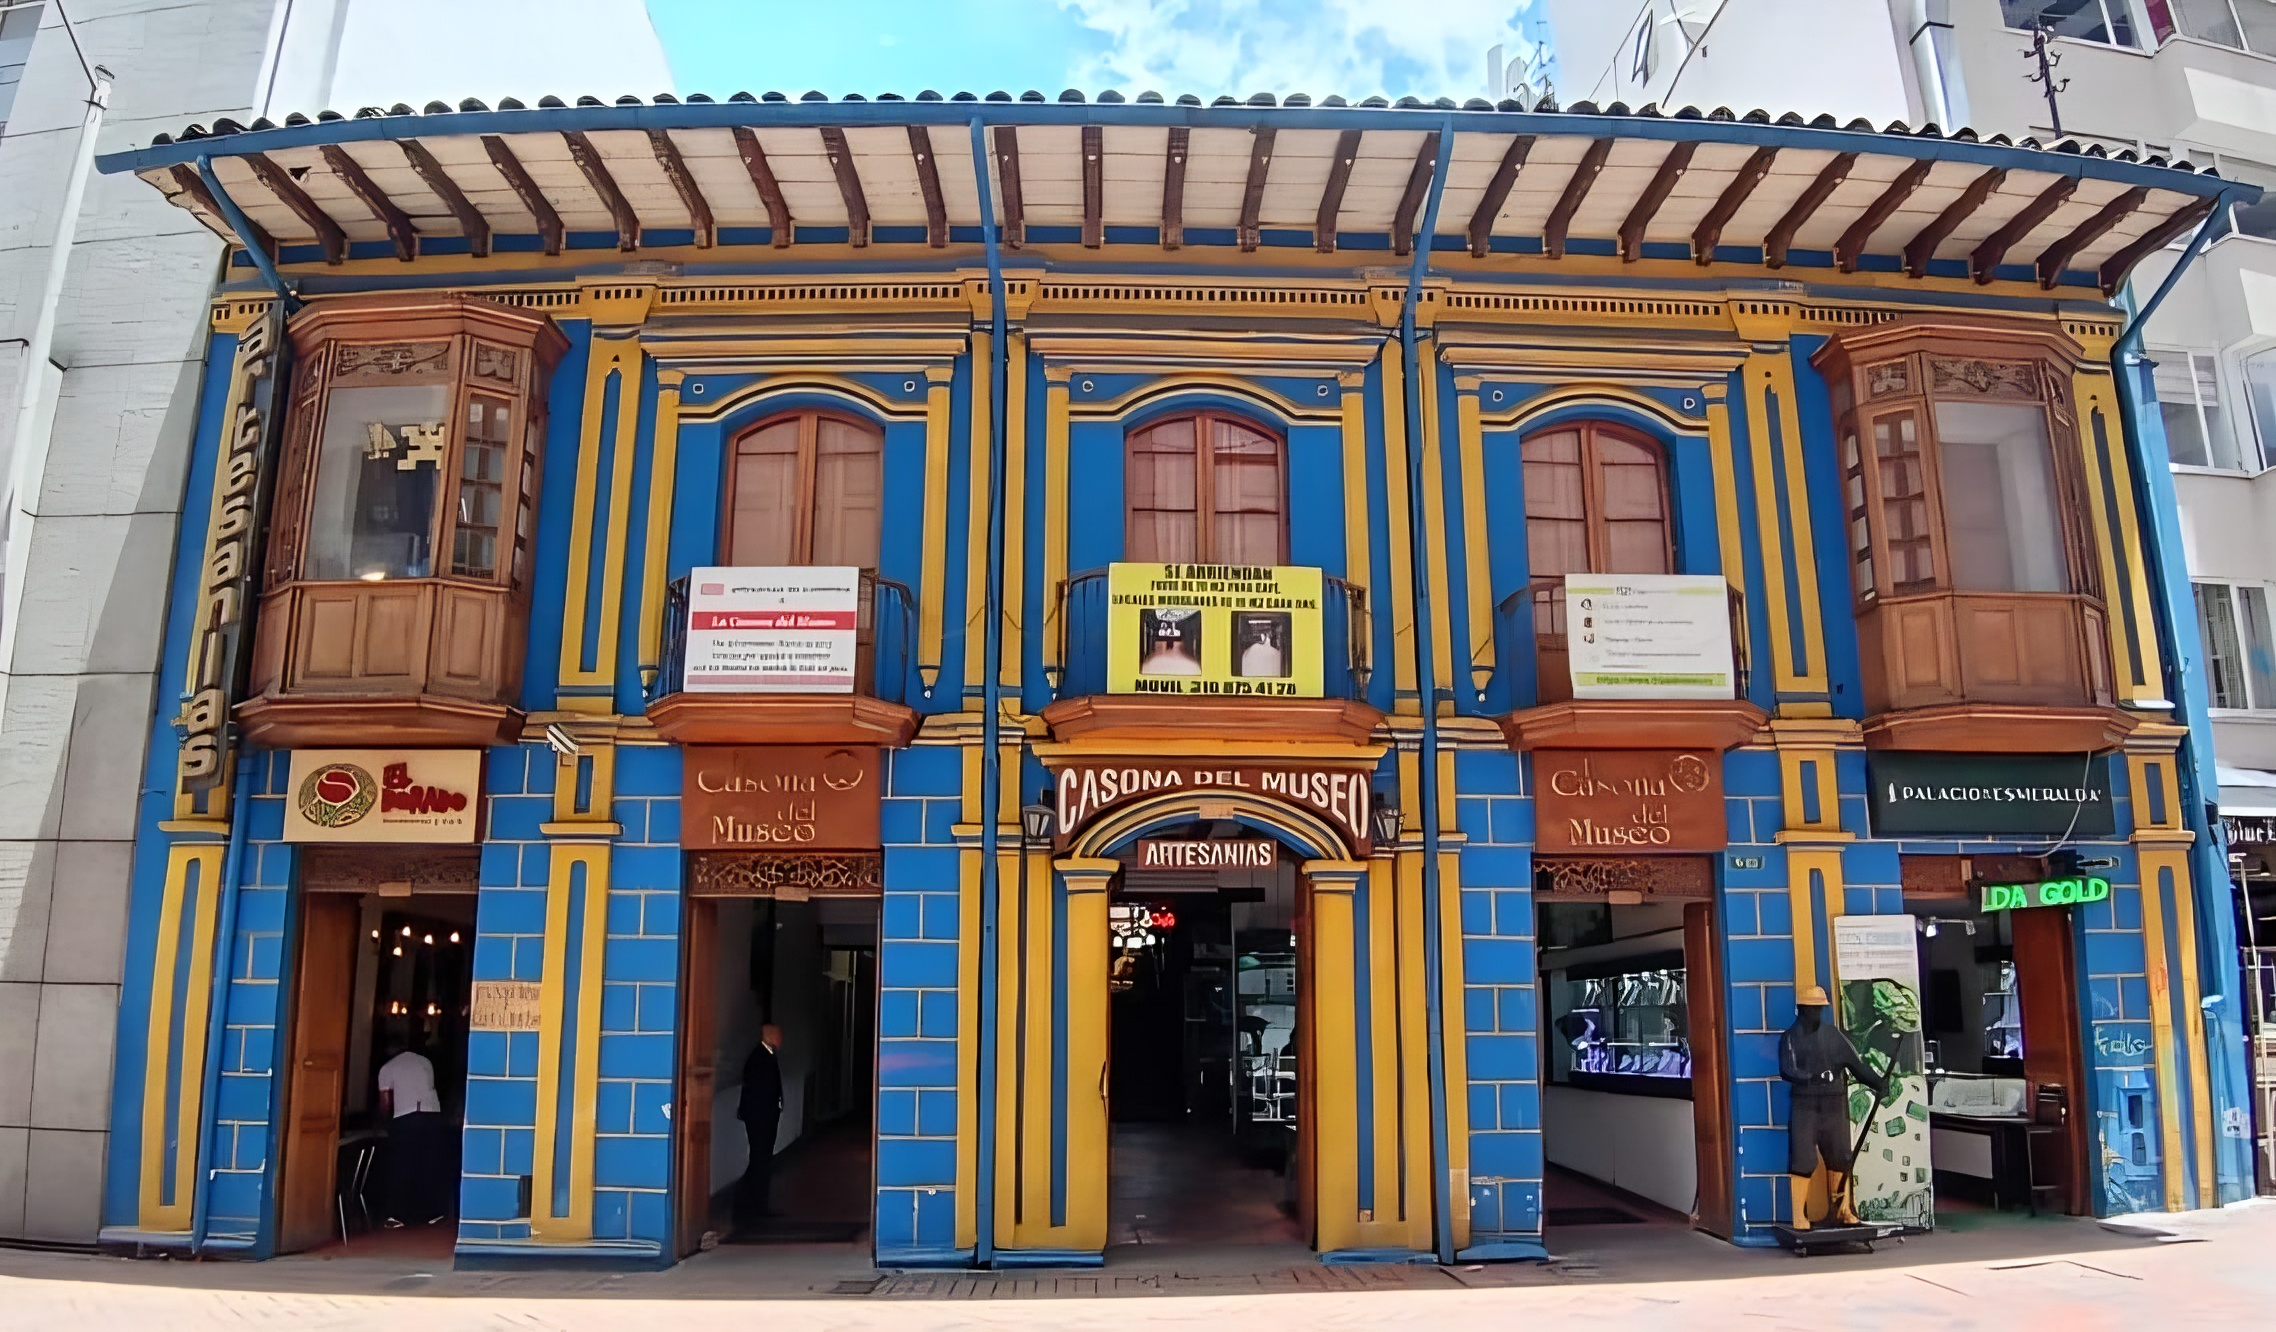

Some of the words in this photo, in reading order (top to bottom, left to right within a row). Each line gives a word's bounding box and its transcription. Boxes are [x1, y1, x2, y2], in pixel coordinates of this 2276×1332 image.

[1059, 768, 1183, 834] CASONA
[1194, 770, 1250, 787] DEL
[1261, 771, 1369, 840] MUSEO
[1145, 842, 1272, 866] ARTESANIAS
[2040, 878, 2109, 905] GOLD
